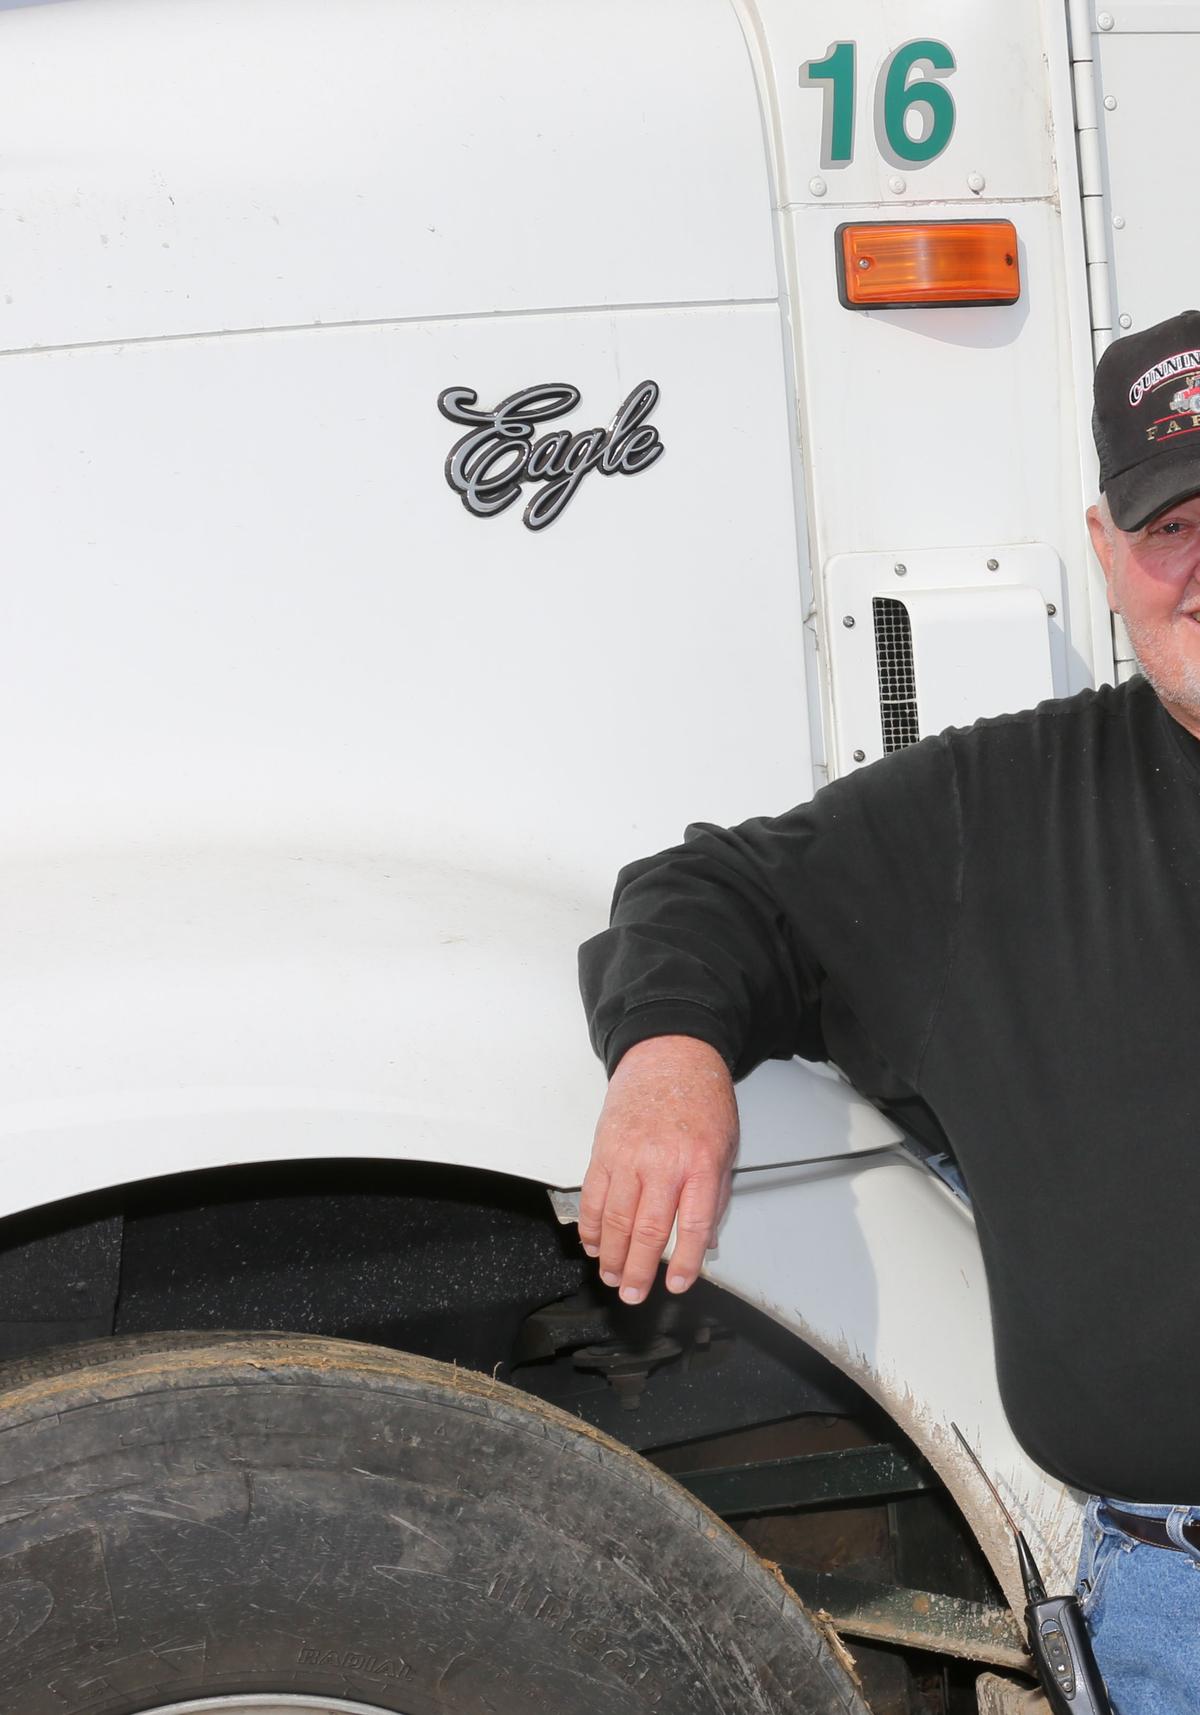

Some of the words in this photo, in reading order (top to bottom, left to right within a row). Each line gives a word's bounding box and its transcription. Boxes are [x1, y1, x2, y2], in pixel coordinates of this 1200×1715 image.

[798, 39, 957, 170] 16
[437, 380, 664, 531] Eagle
[297, 1648, 417, 1682] RADIAL
